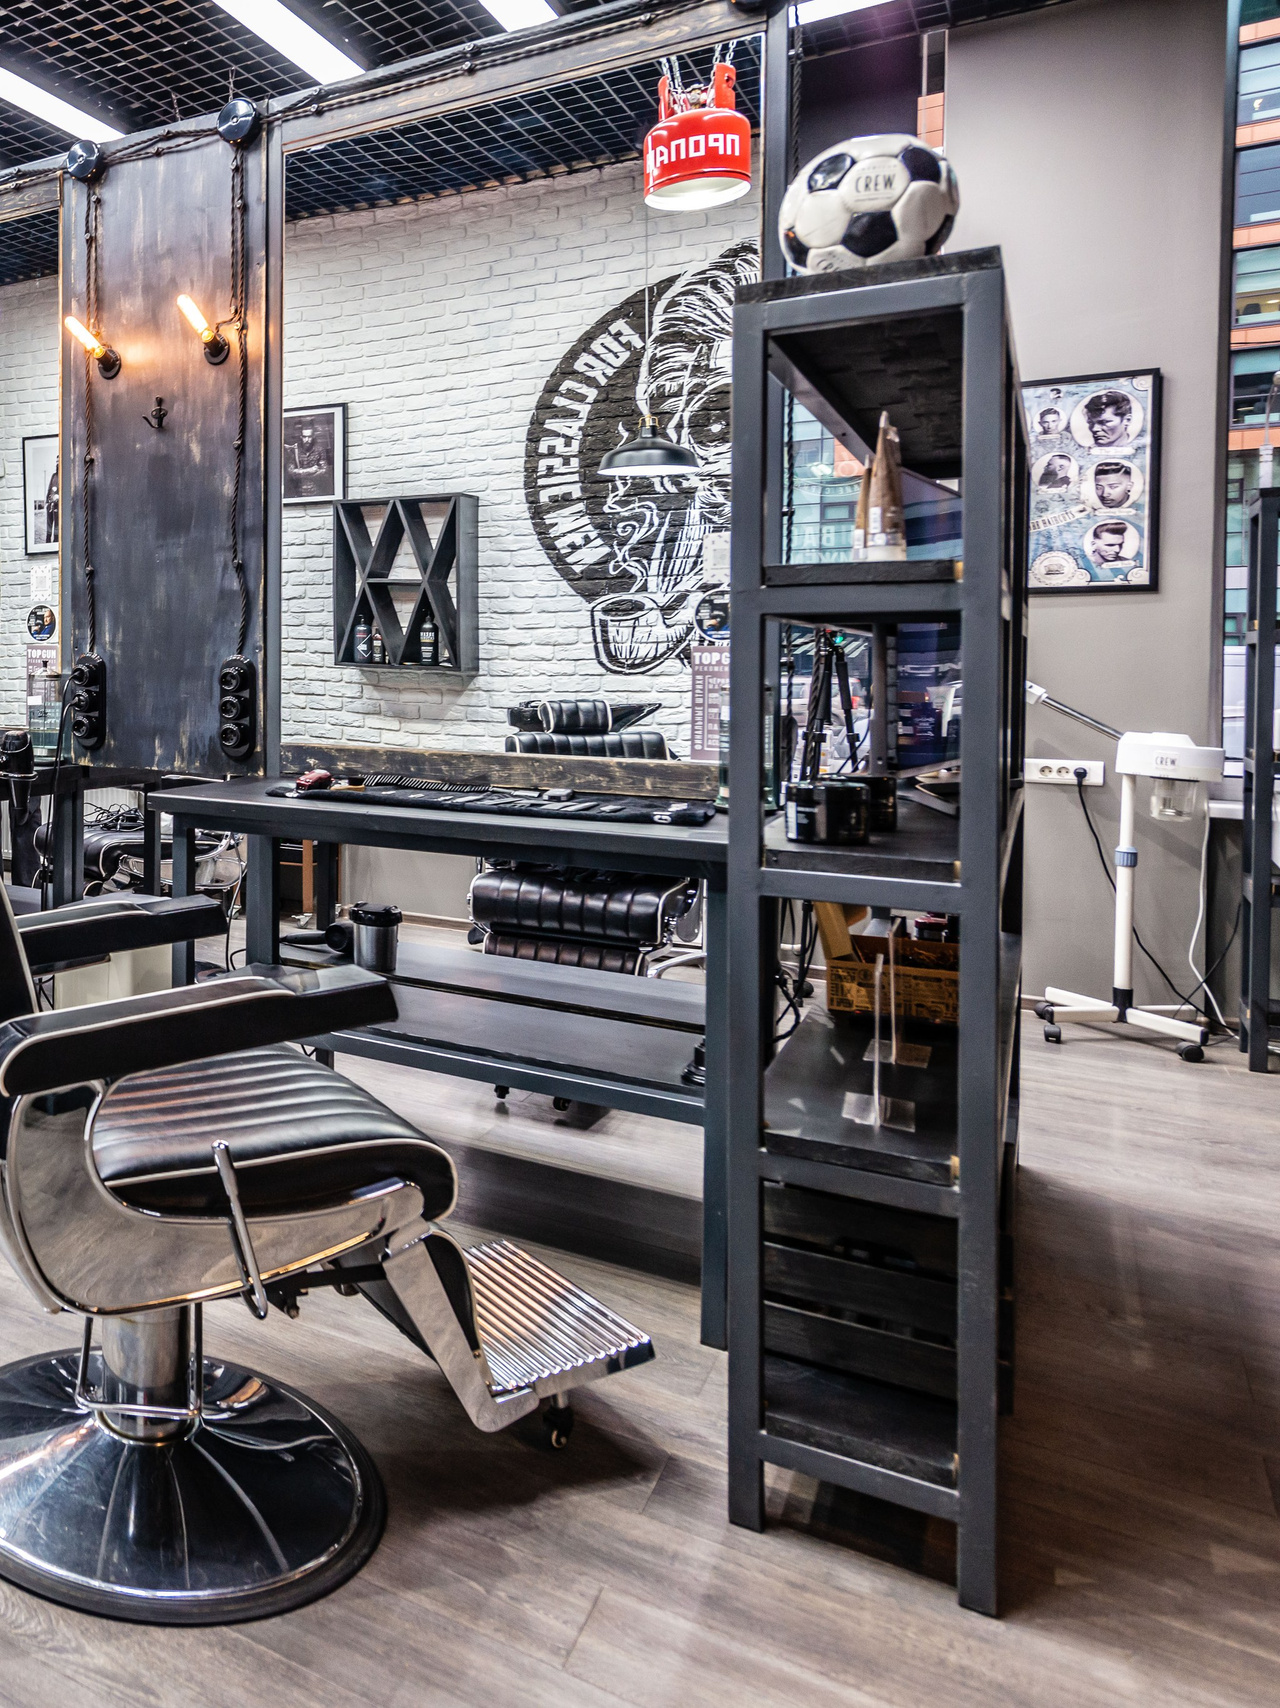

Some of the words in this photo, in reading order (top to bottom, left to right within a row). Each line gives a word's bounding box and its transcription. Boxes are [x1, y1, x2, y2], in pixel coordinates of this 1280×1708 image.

[855, 173, 897, 193] CREW
[694, 675, 704, 704] ШТРИХИ
[693, 706, 704, 750] ФИНАЛЬНЫЕ
[1155, 756, 1177, 766] CREW
